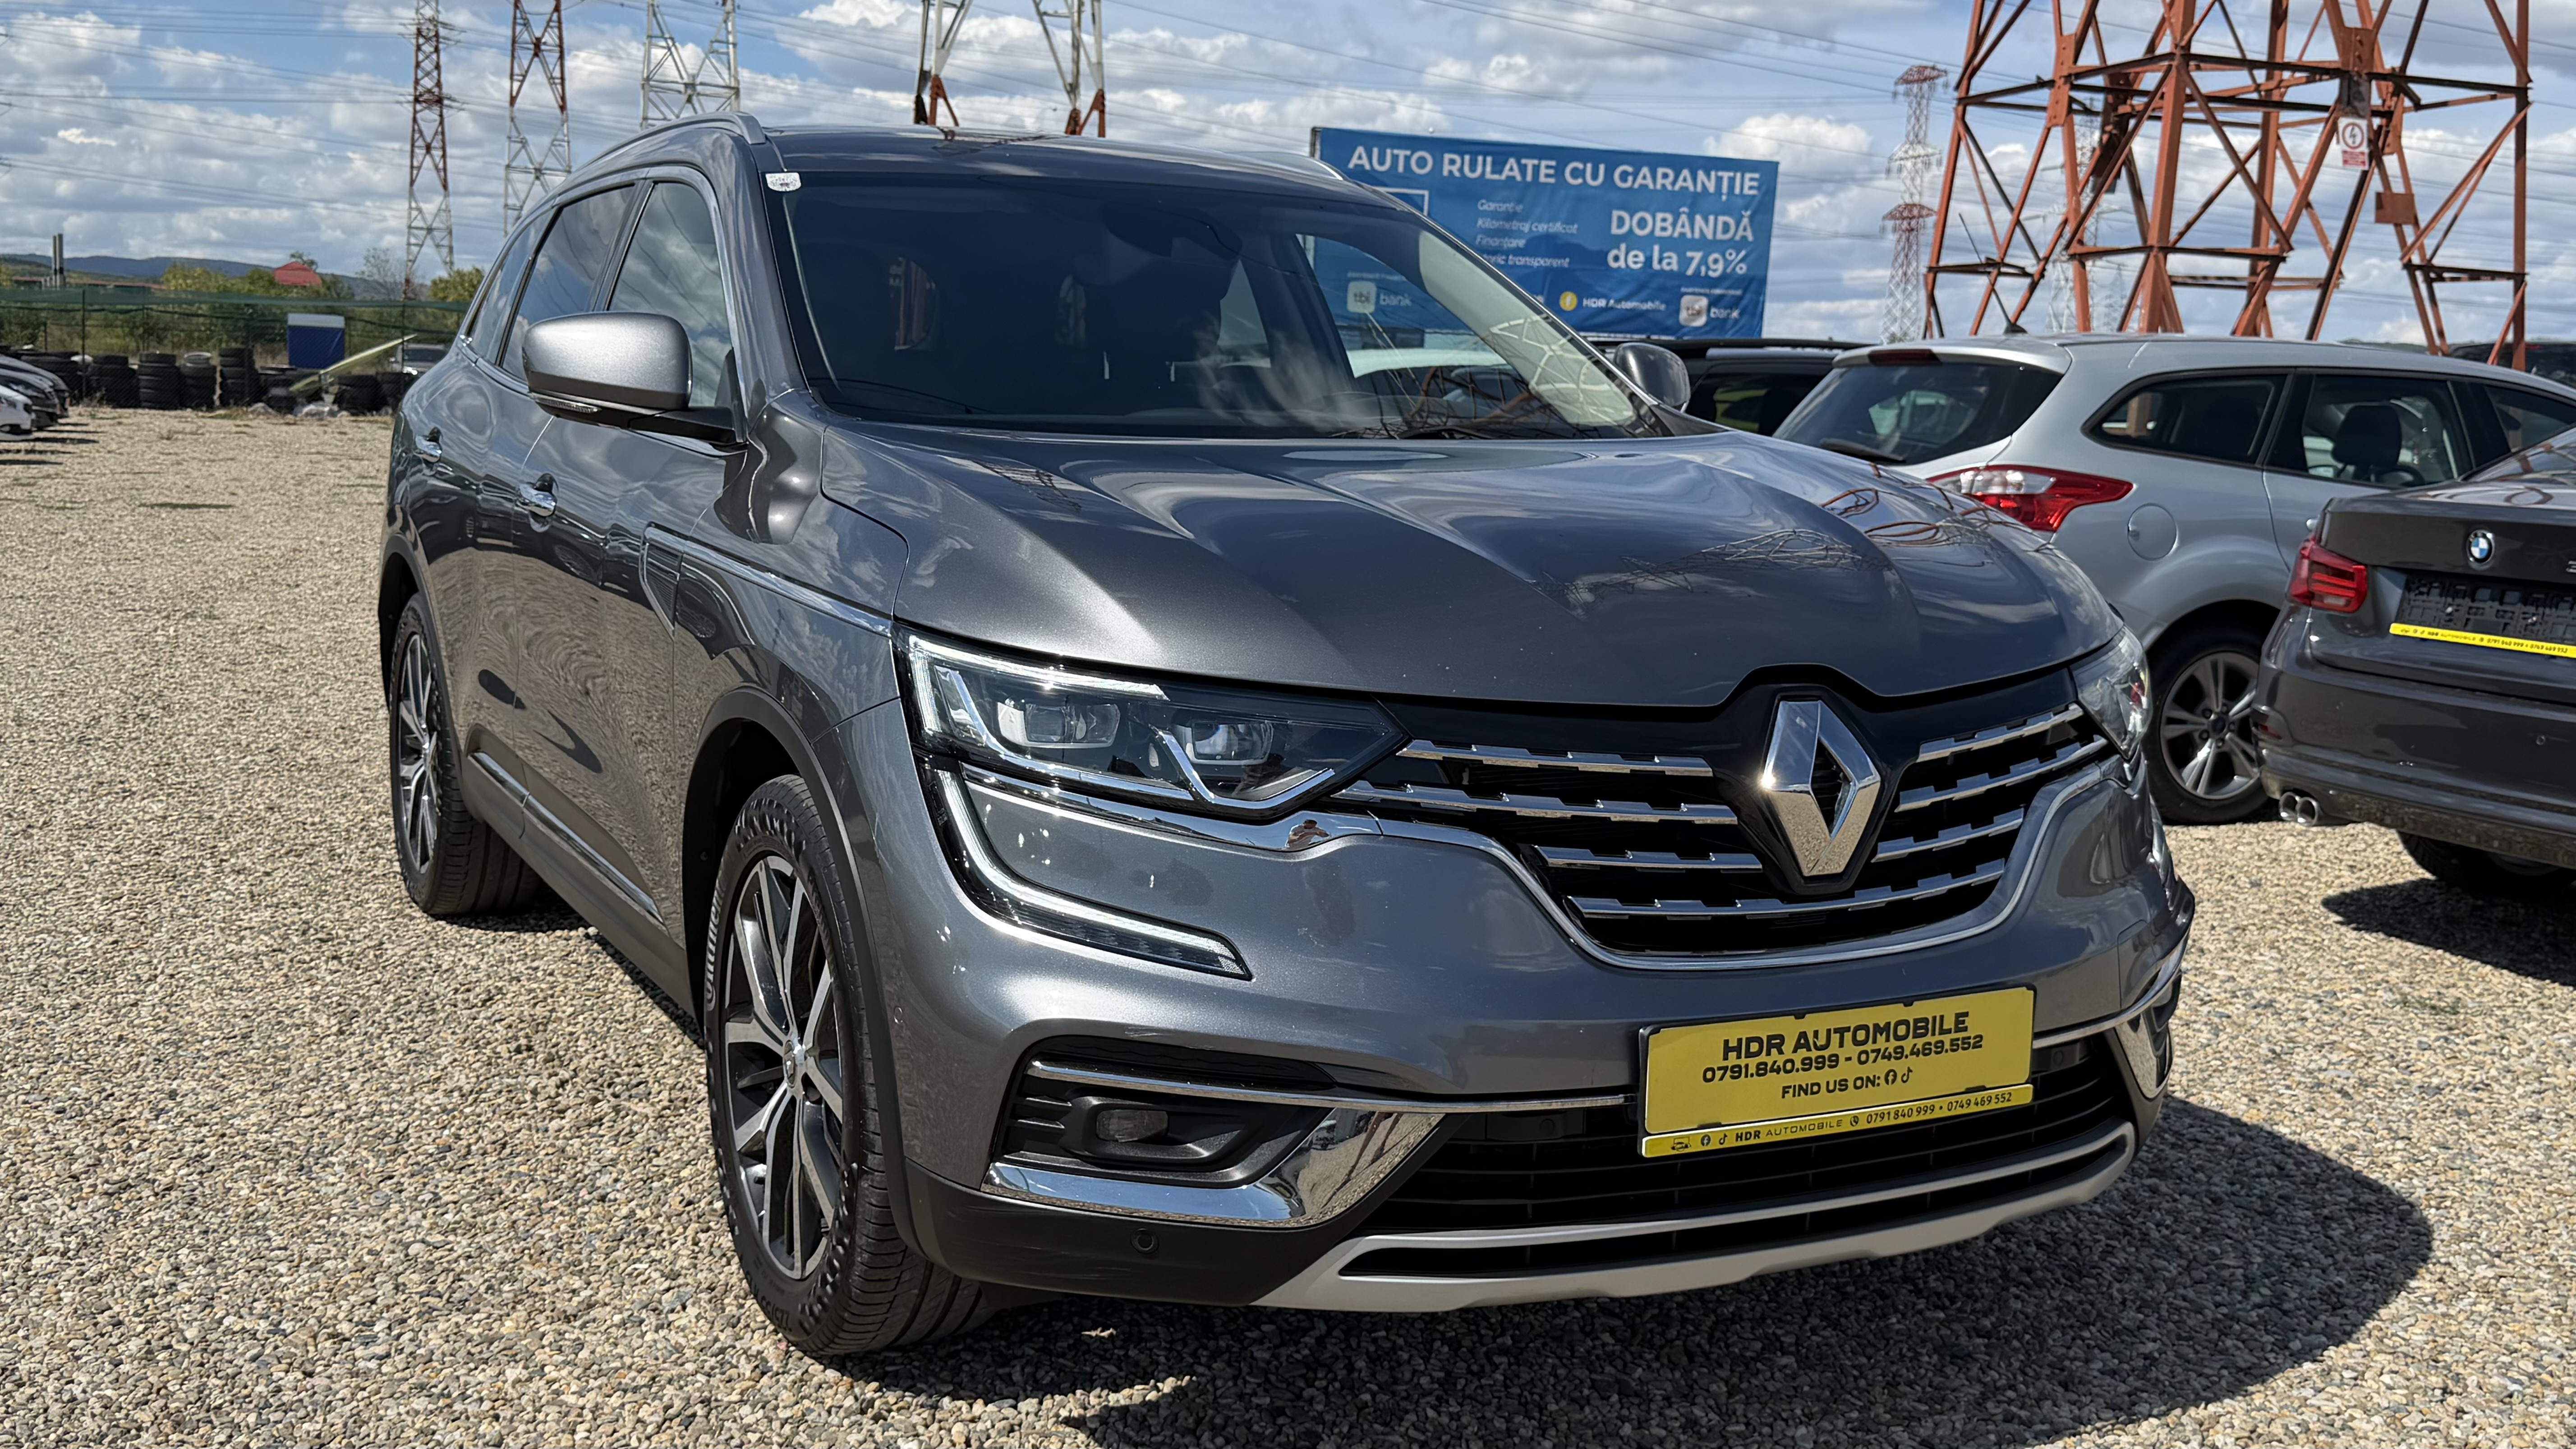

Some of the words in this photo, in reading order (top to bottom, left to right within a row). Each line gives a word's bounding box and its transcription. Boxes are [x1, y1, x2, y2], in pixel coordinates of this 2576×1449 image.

[1348, 146, 1433, 175] AUTO
[1442, 153, 1556, 183] RULATE
[1564, 161, 1605, 186] CU
[1613, 165, 1760, 201] GARANȚIE
[1610, 207, 1754, 242] DOBÂNDĂ
[1607, 243, 1645, 270] de
[1652, 244, 1678, 271] la
[1686, 249, 1747, 278] 7,9%
[1702, 1053, 1840, 1083] 0791.840.999
[1857, 1034, 1983, 1065] 0749.469.552
[1722, 1034, 1785, 1061] HDR
[1792, 1011, 1969, 1054] AUTOMOBILE
[1781, 1082, 1821, 1099] FIND
[1826, 1078, 1849, 1093] US
[1853, 1074, 1881, 1090] ON:
[1735, 1130, 1761, 1142] HDR
[1766, 1119, 1843, 1137] AUTOMOBILE
[1866, 1111, 1891, 1124] 0791
[1893, 1108, 1914, 1121] 840
[1916, 1104, 1936, 1117] 999
[1947, 1098, 1971, 1111] 0749
[1973, 1094, 1992, 1107] 469
[1994, 1092, 2012, 1104] 552
